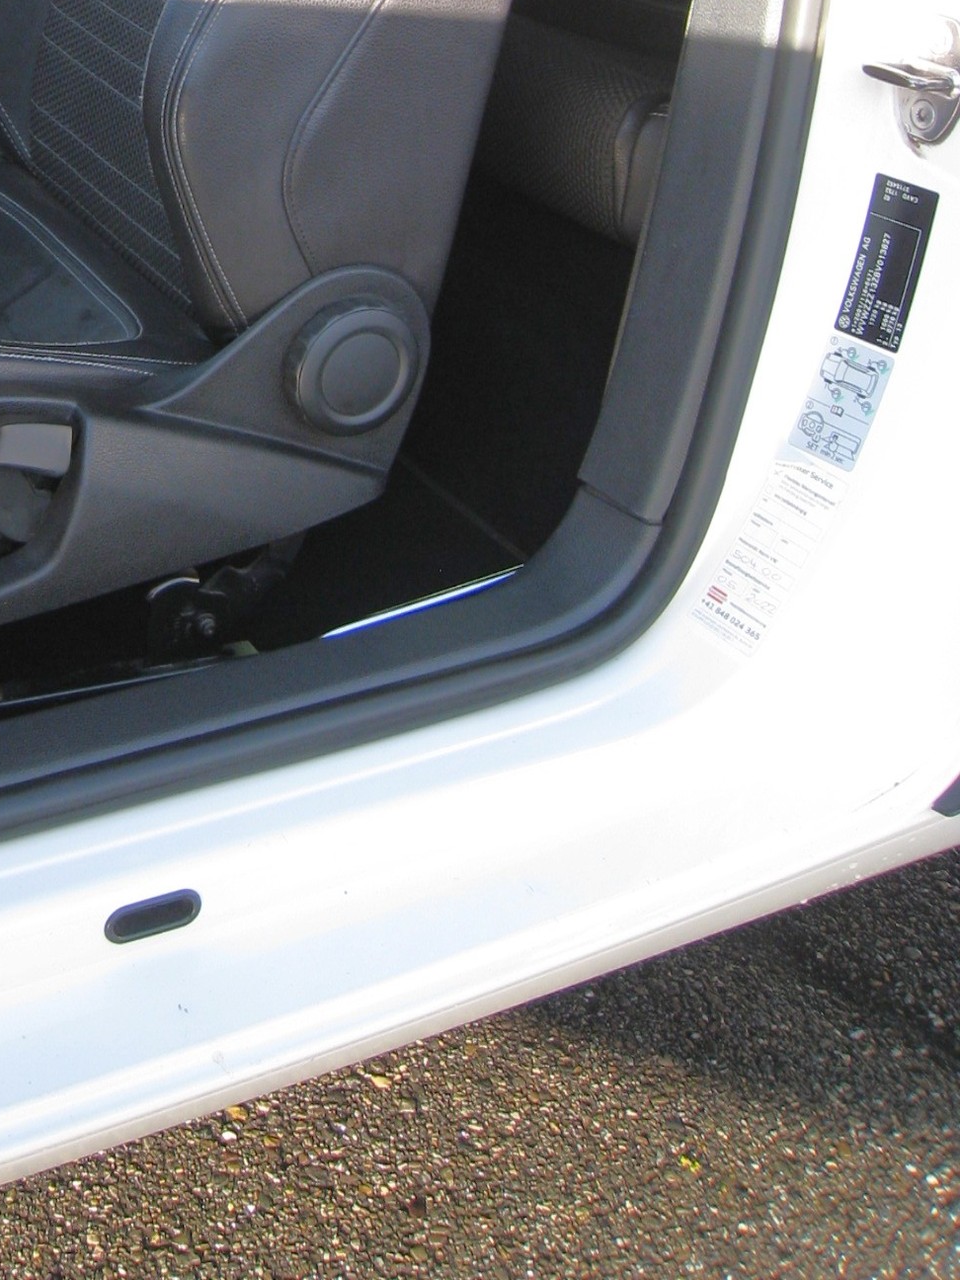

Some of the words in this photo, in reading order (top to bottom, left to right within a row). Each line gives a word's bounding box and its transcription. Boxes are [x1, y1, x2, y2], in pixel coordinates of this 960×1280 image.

[842, 255, 866, 313] VOLKSWAGEN
[862, 236, 872, 251] AG
[805, 442, 819, 452] SET
[810, 471, 834, 490] Service
[701, 598, 715, 611] +41
[714, 607, 730, 620] 848
[729, 616, 745, 630] 024
[745, 627, 761, 641] 365
